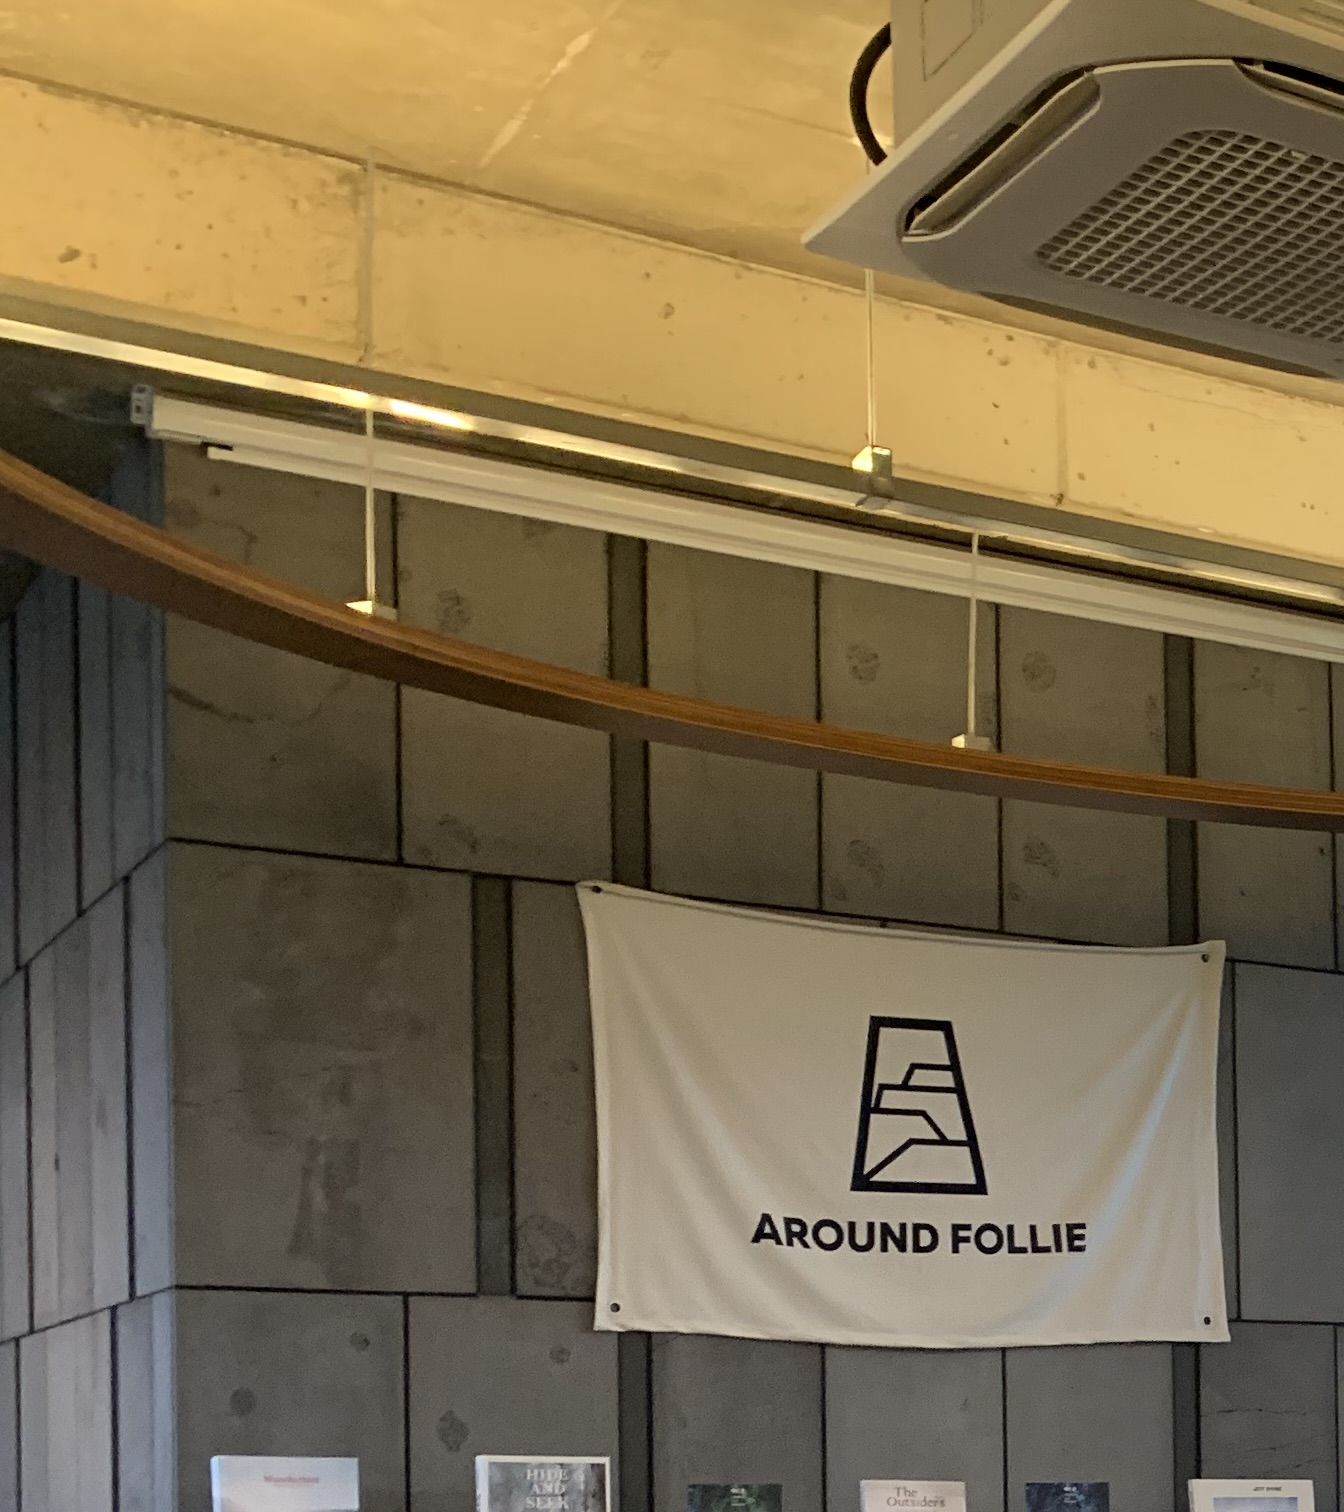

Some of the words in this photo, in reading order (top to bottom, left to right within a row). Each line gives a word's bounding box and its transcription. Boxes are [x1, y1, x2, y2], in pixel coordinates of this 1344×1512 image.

[751, 1212, 939, 1254] AROUND
[951, 1222, 1087, 1255] FOLLIE
[526, 1468, 569, 1481] HIDE
[532, 1482, 566, 1495] AND
[895, 1486, 918, 1498] The
[526, 1496, 569, 1509] SEEK
[886, 1495, 946, 1508] Outsiders
